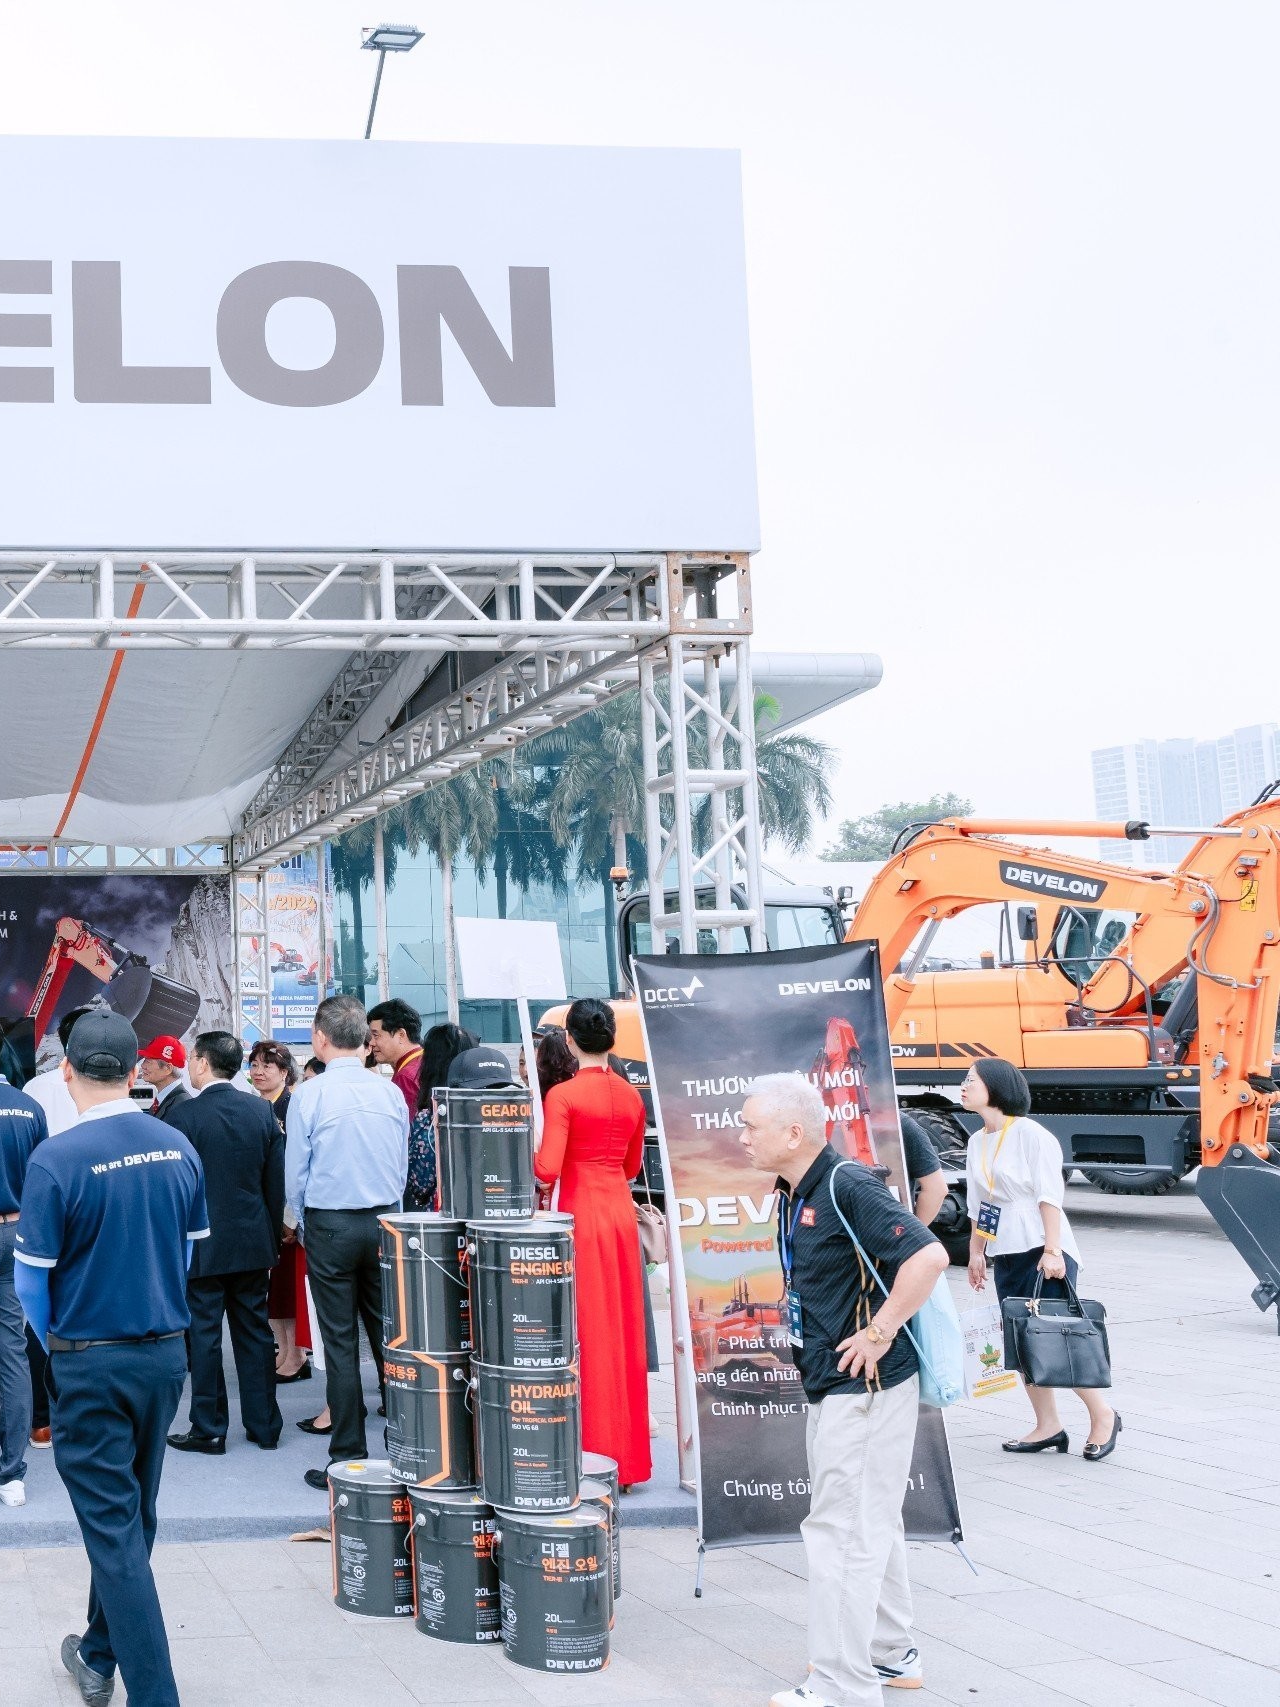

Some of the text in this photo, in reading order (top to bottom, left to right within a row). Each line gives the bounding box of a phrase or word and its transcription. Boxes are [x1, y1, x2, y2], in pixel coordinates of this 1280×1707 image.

[1005, 866, 1099, 898] DEVELON
[9, 910, 18, 921] &
[778, 978, 871, 996] DEVELON
[644, 988, 680, 1003] DCC
[682, 1075, 753, 1097] THƯƠN
[824, 1067, 861, 1089] MỚI
[481, 1103, 532, 1117] GEAR OIL
[691, 1101, 861, 1130] THÁC MỚI
[91, 1150, 182, 1175] We are DEVELON
[483, 1174, 501, 1183] 20L
[484, 1207, 532, 1217] DEVELON
[700, 1236, 773, 1254] Powered
[509, 1246, 560, 1260] DIESEL
[510, 1261, 563, 1276] ENGINE
[512, 1313, 530, 1323] 20L
[729, 1335, 767, 1350] Phát
[513, 1356, 568, 1367] DEVELON
[730, 1366, 760, 1382] đến
[510, 1399, 536, 1414] OIL
[711, 1401, 798, 1419] Chinh phục
[513, 1447, 531, 1457] 20L
[391, 1466, 418, 1481] VELON
[723, 1479, 784, 1500] Chúng
[514, 1495, 570, 1507] DEVELON
[541, 1542, 570, 1558] 디젤
[393, 1558, 409, 1567] 20L
[541, 1555, 599, 1573] 엔진 오일
[474, 1587, 491, 1597] 20L
[394, 1604, 415, 1614] DEV
[544, 1613, 563, 1623] 20L
[475, 1630, 501, 1641] DEV
[545, 1656, 602, 1670] DEVELON
